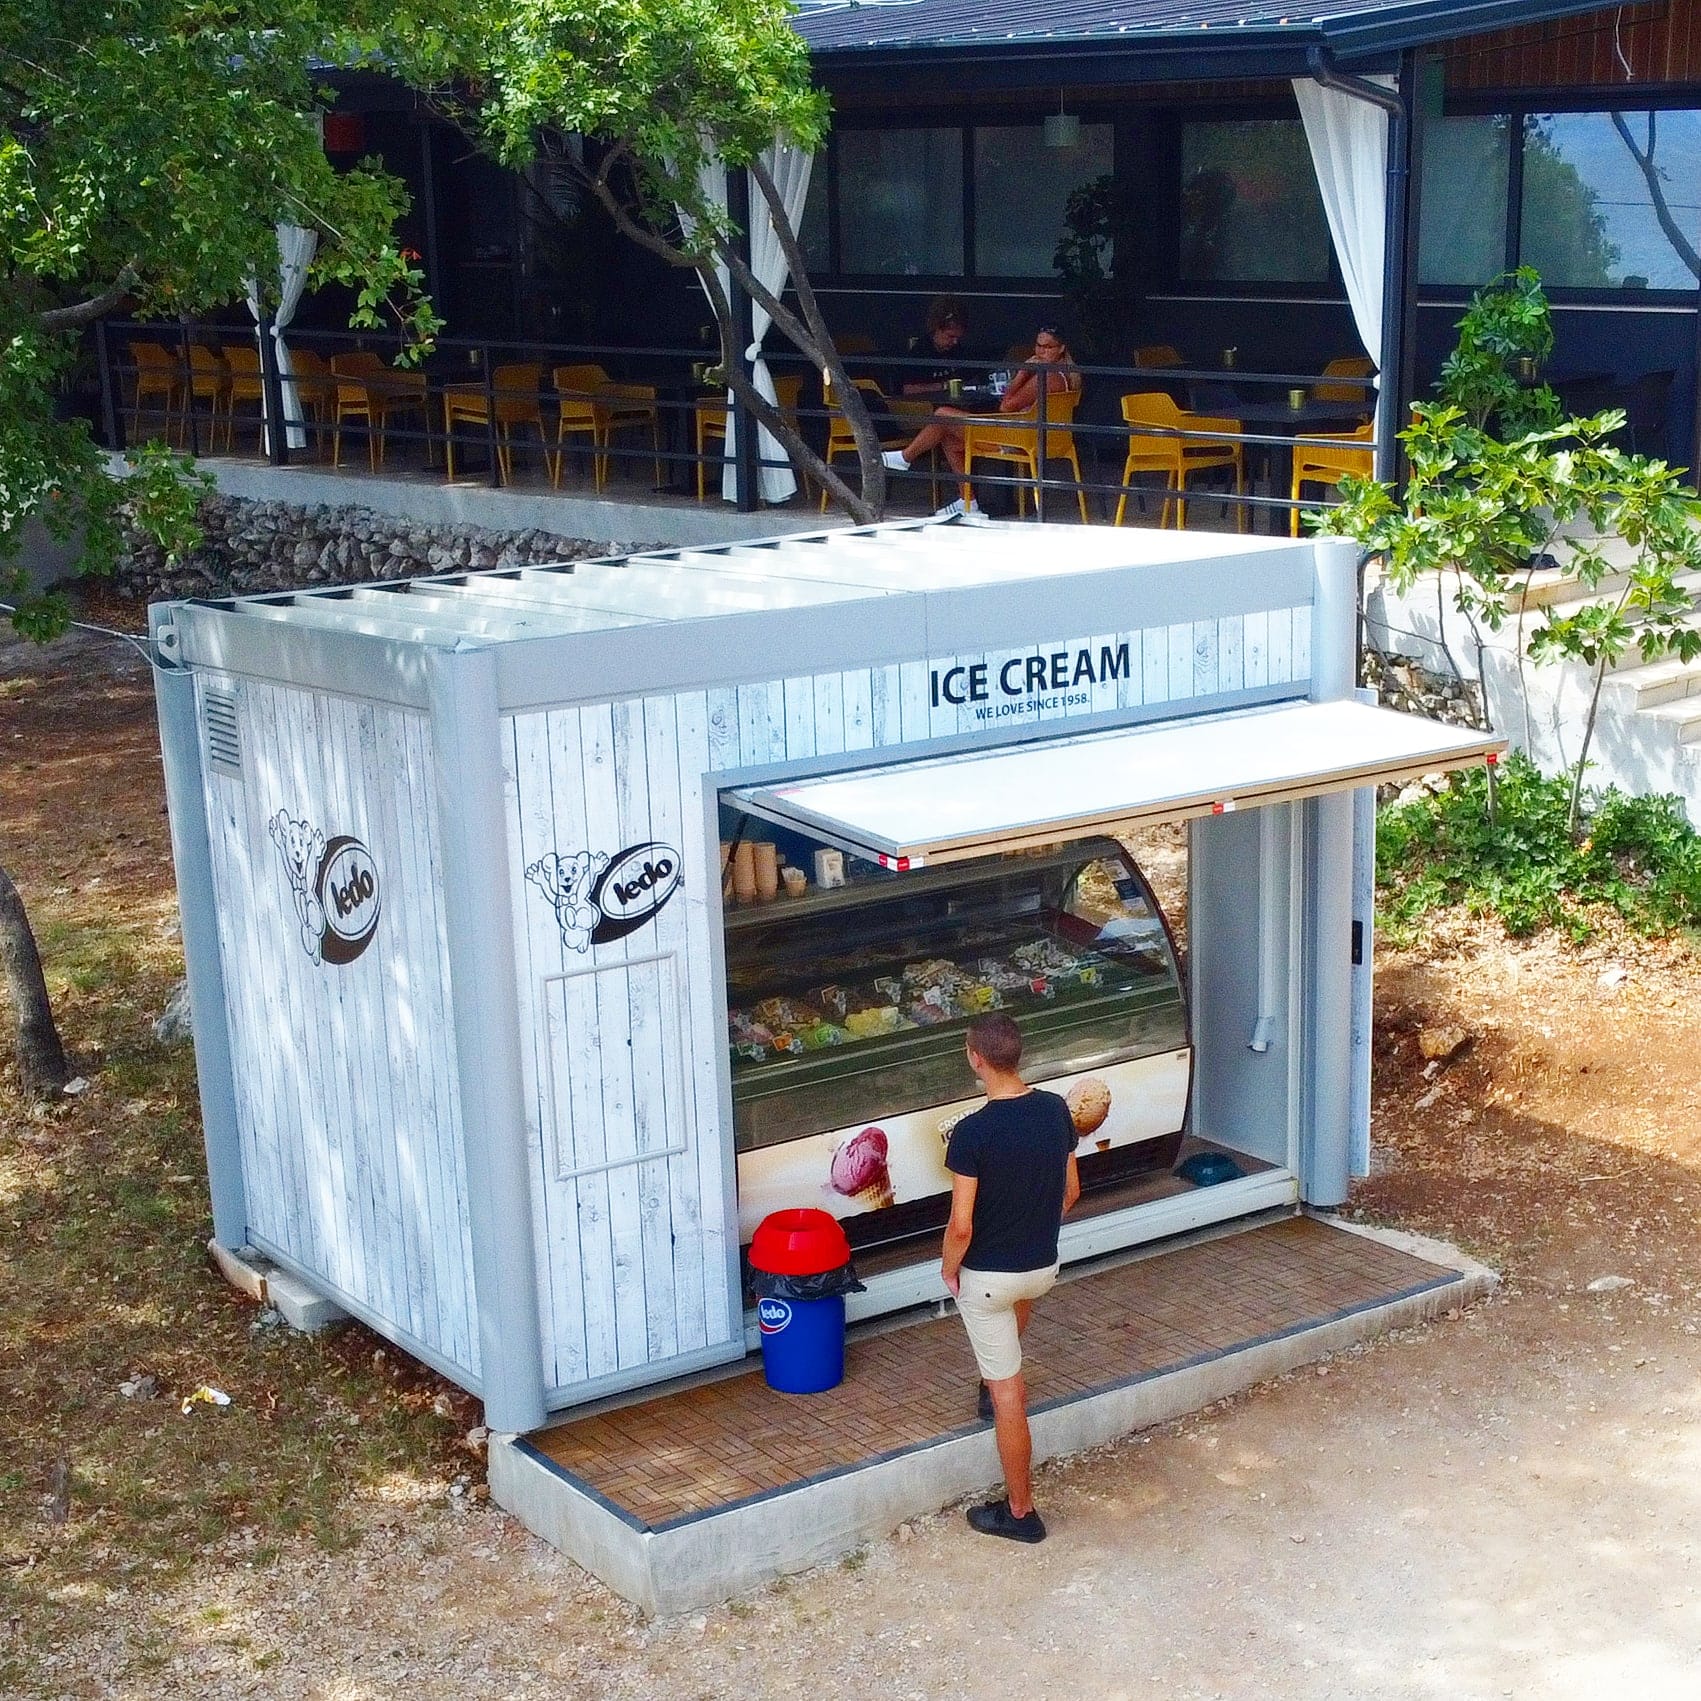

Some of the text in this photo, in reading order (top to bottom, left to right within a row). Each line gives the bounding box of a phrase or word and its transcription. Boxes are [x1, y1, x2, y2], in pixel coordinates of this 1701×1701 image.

[930, 643, 1130, 707] ICE CREAM
[975, 707, 994, 720] WE
[995, 702, 1025, 718] LOVE
[1026, 696, 1059, 713] SINCE
[330, 861, 374, 919] ledo
[613, 859, 673, 906] ledo
[760, 1304, 786, 1319] ledo
